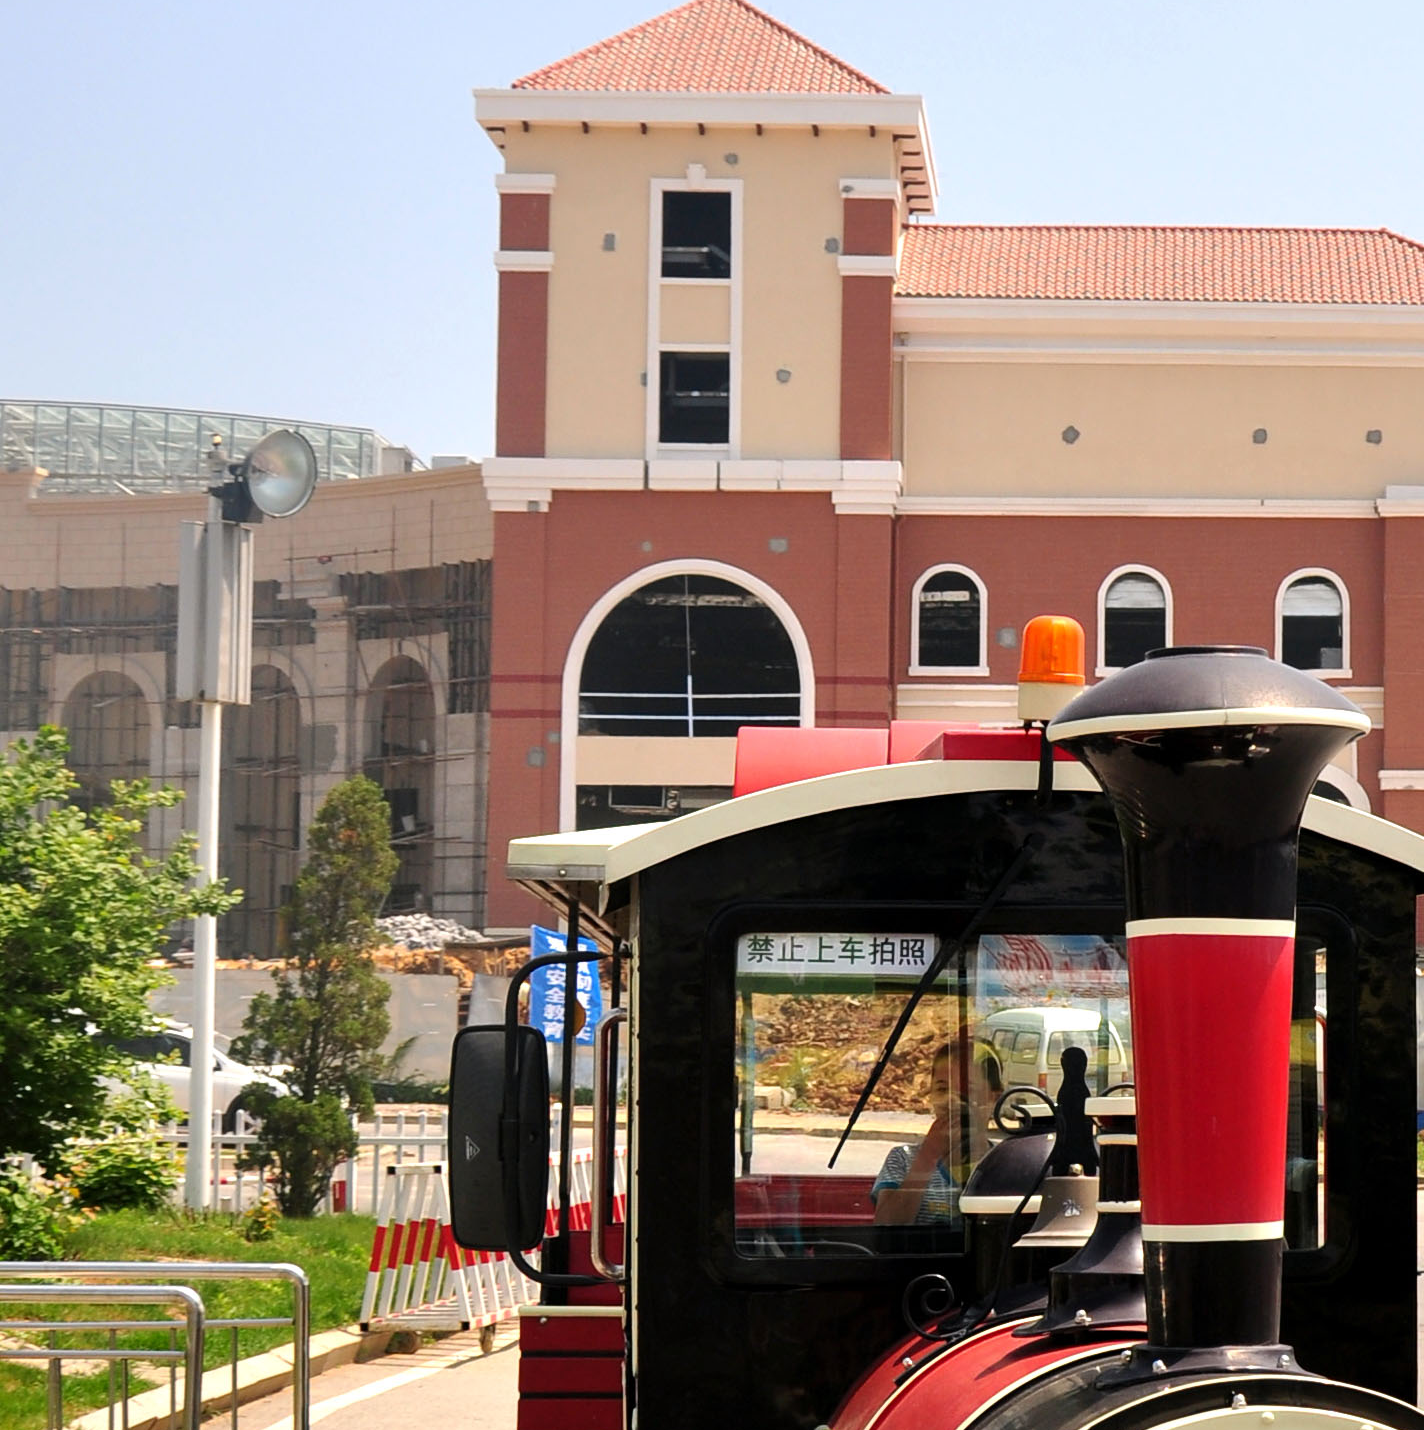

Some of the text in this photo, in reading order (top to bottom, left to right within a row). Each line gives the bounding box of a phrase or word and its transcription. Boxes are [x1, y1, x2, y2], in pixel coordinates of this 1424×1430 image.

[747, 935, 926, 966] 禁止上车拍照
